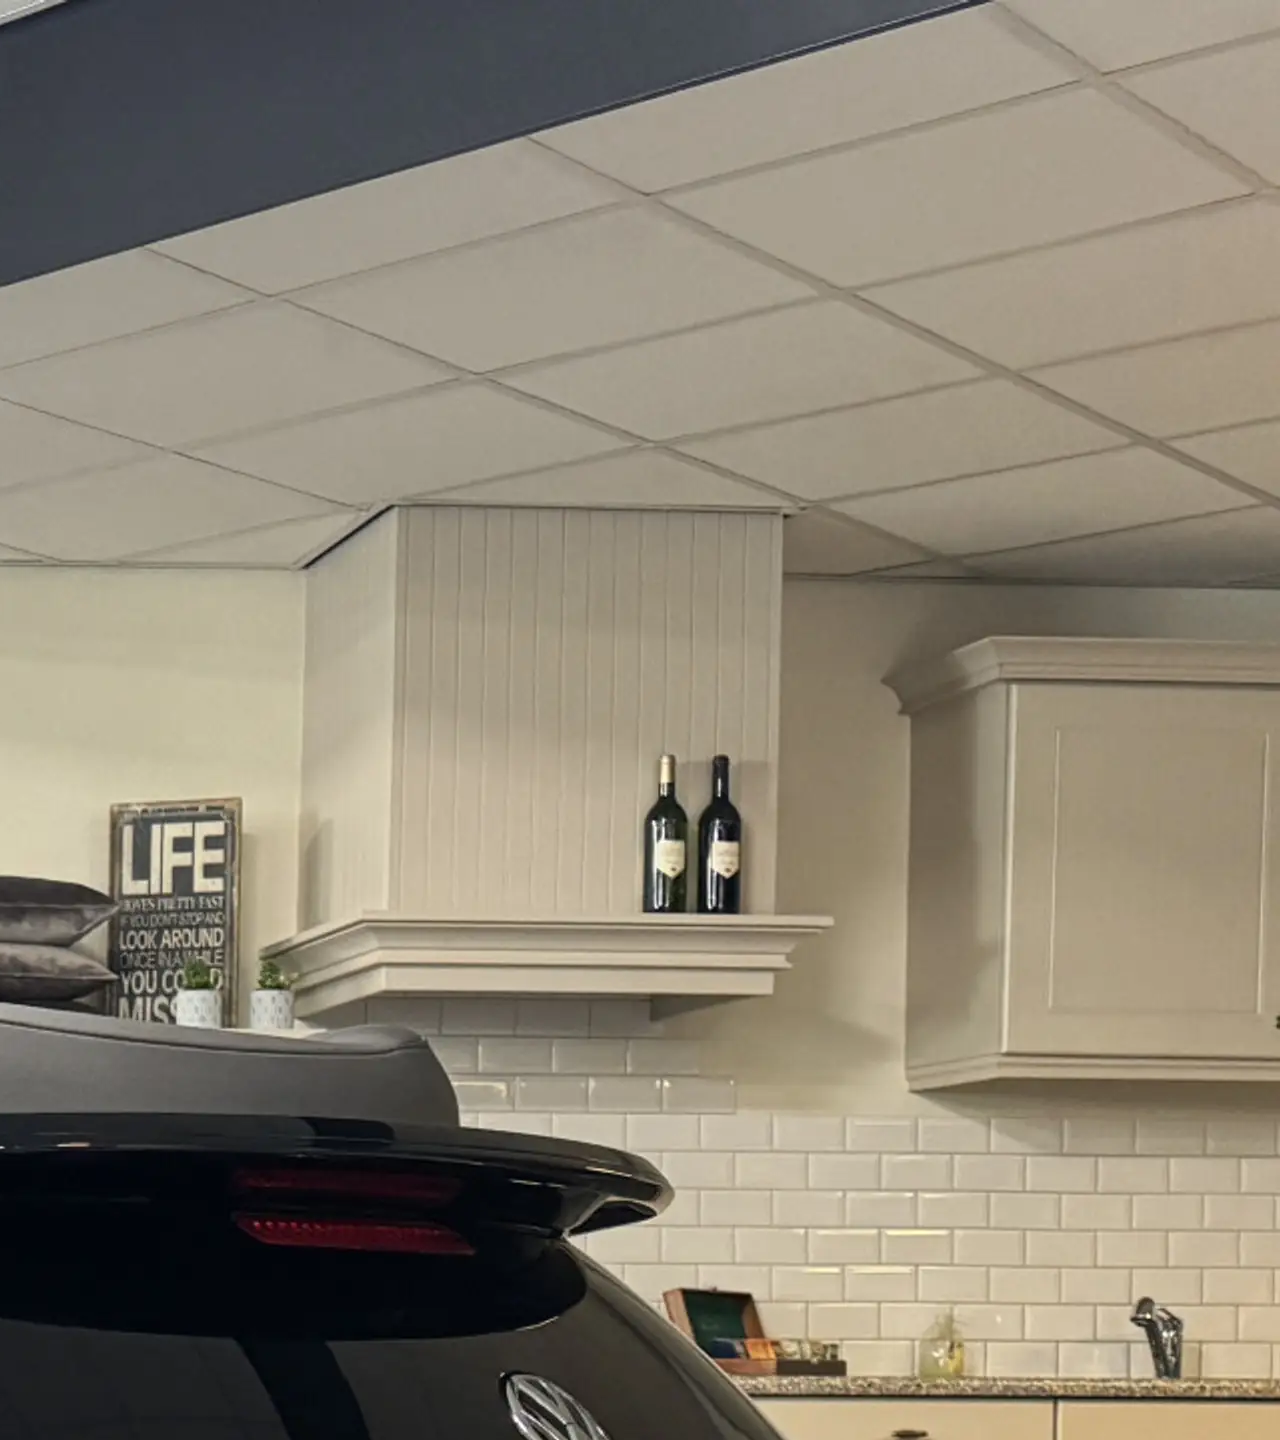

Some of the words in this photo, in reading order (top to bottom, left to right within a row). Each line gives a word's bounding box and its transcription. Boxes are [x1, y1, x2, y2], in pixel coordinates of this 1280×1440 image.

[122, 821, 225, 895] LIFE
[158, 896, 197, 910] PRETTY
[199, 896, 224, 909] FAST
[119, 929, 157, 950] LOOK
[160, 927, 225, 949] AROUND
[119, 970, 158, 995] YOU
[161, 967, 224, 994] COD
